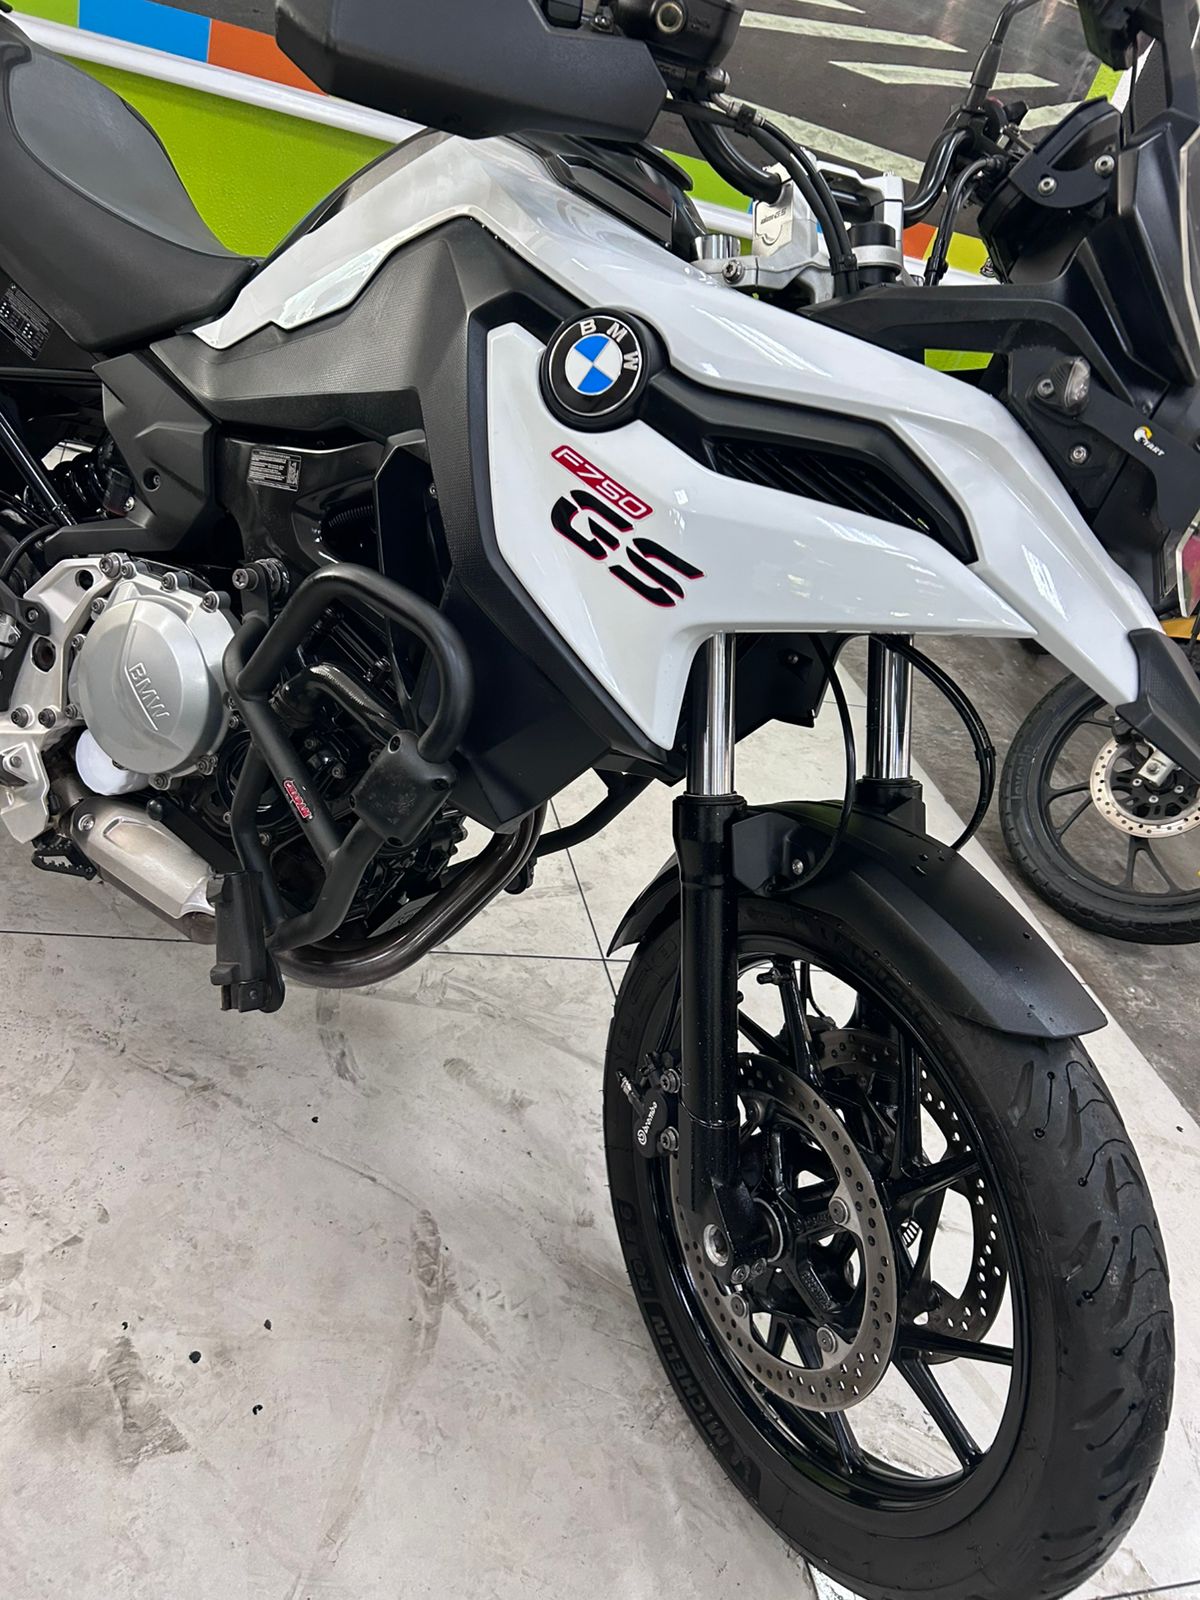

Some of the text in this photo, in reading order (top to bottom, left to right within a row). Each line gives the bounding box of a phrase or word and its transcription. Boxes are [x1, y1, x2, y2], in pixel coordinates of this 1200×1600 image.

[579, 317, 642, 372] BMW
[553, 447, 649, 518] F750
[550, 489, 705, 608] GS
[128, 661, 170, 719] BMW
[652, 1315, 731, 1448] MICHELIN
